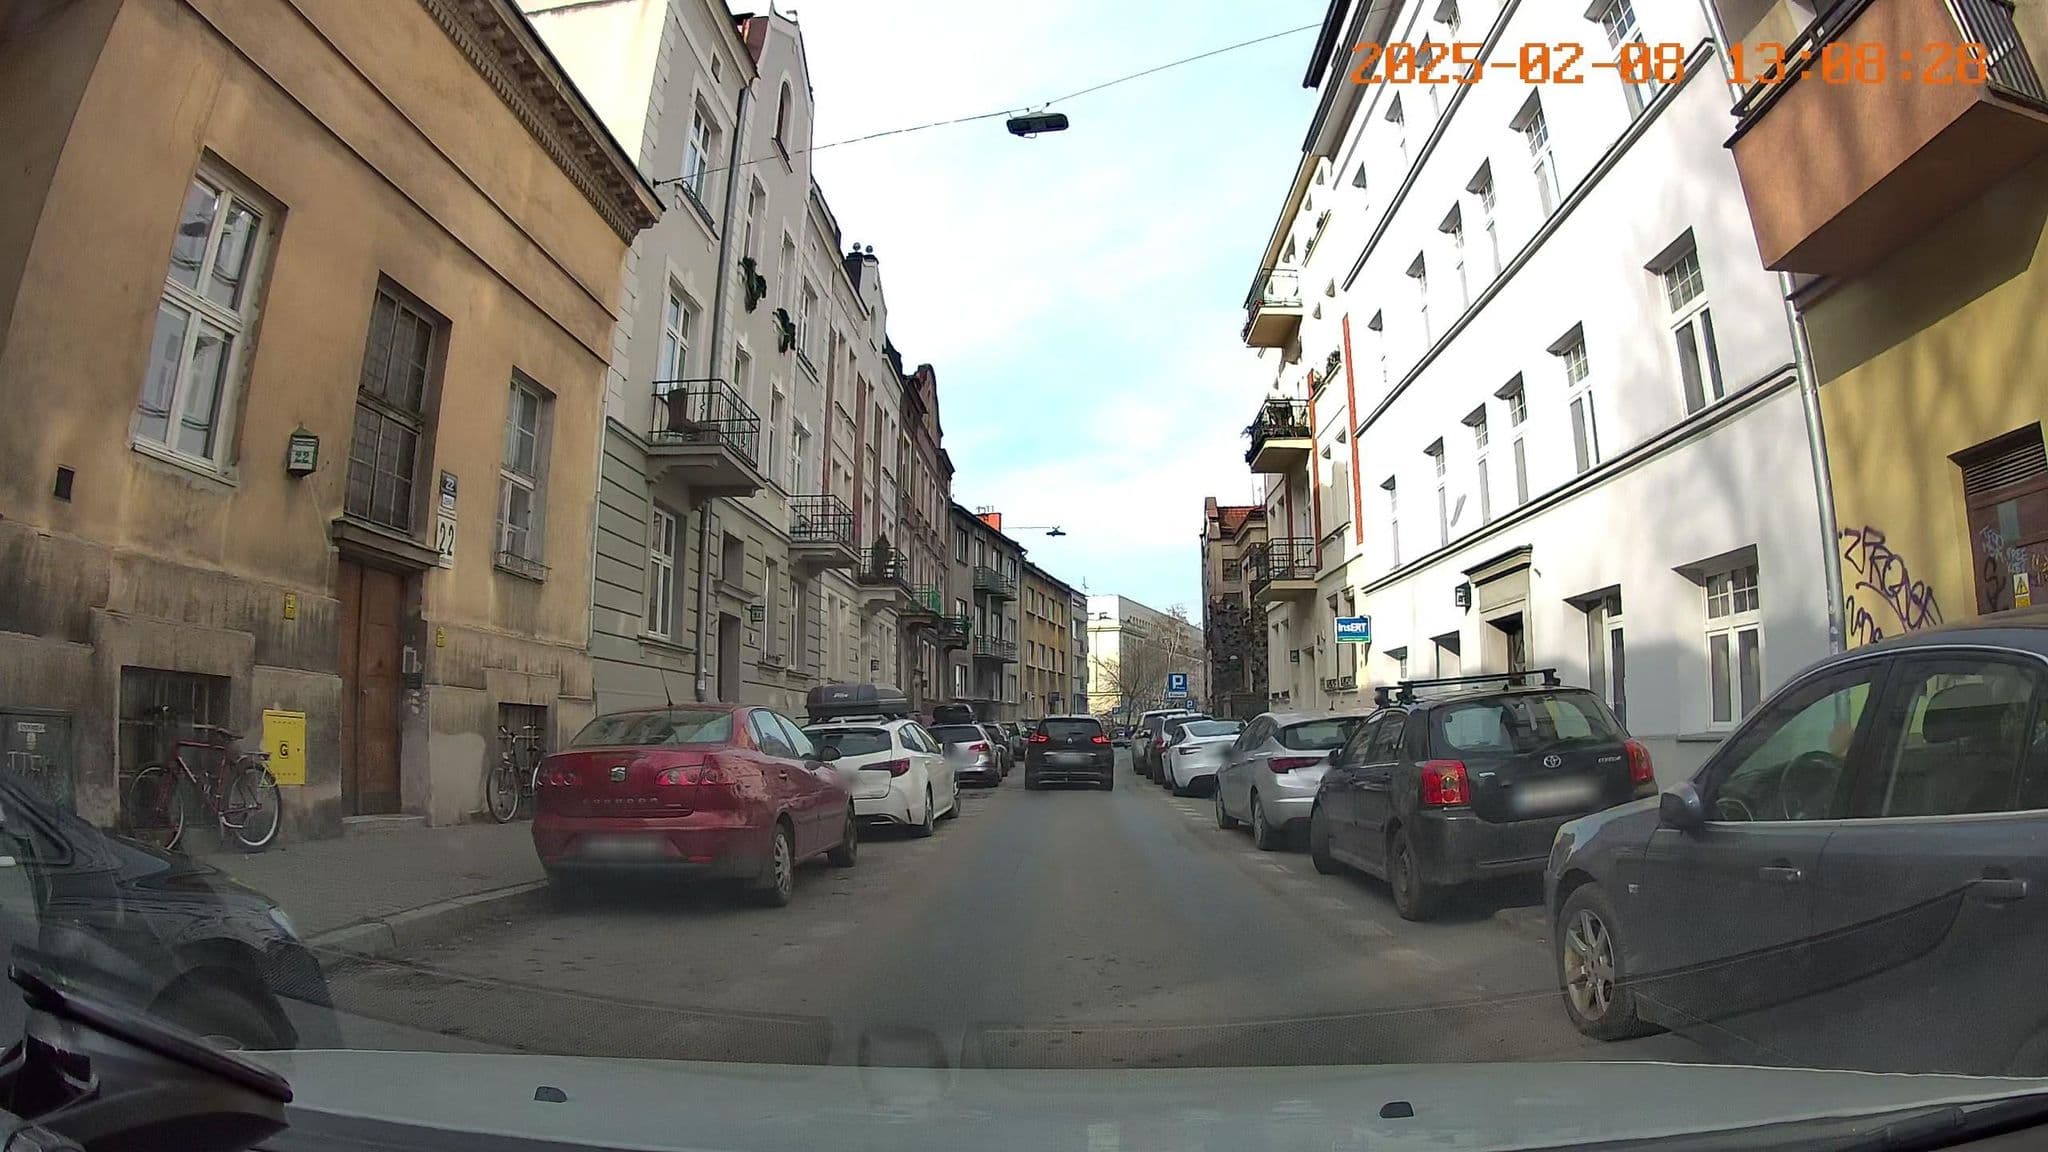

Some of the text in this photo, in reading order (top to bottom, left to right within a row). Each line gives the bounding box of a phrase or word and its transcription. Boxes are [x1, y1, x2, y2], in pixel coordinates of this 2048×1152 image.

[439, 521, 454, 556] 22
[1338, 622, 1367, 632] InsERT
[1172, 674, 1183, 689] P
[280, 743, 289, 757] G
